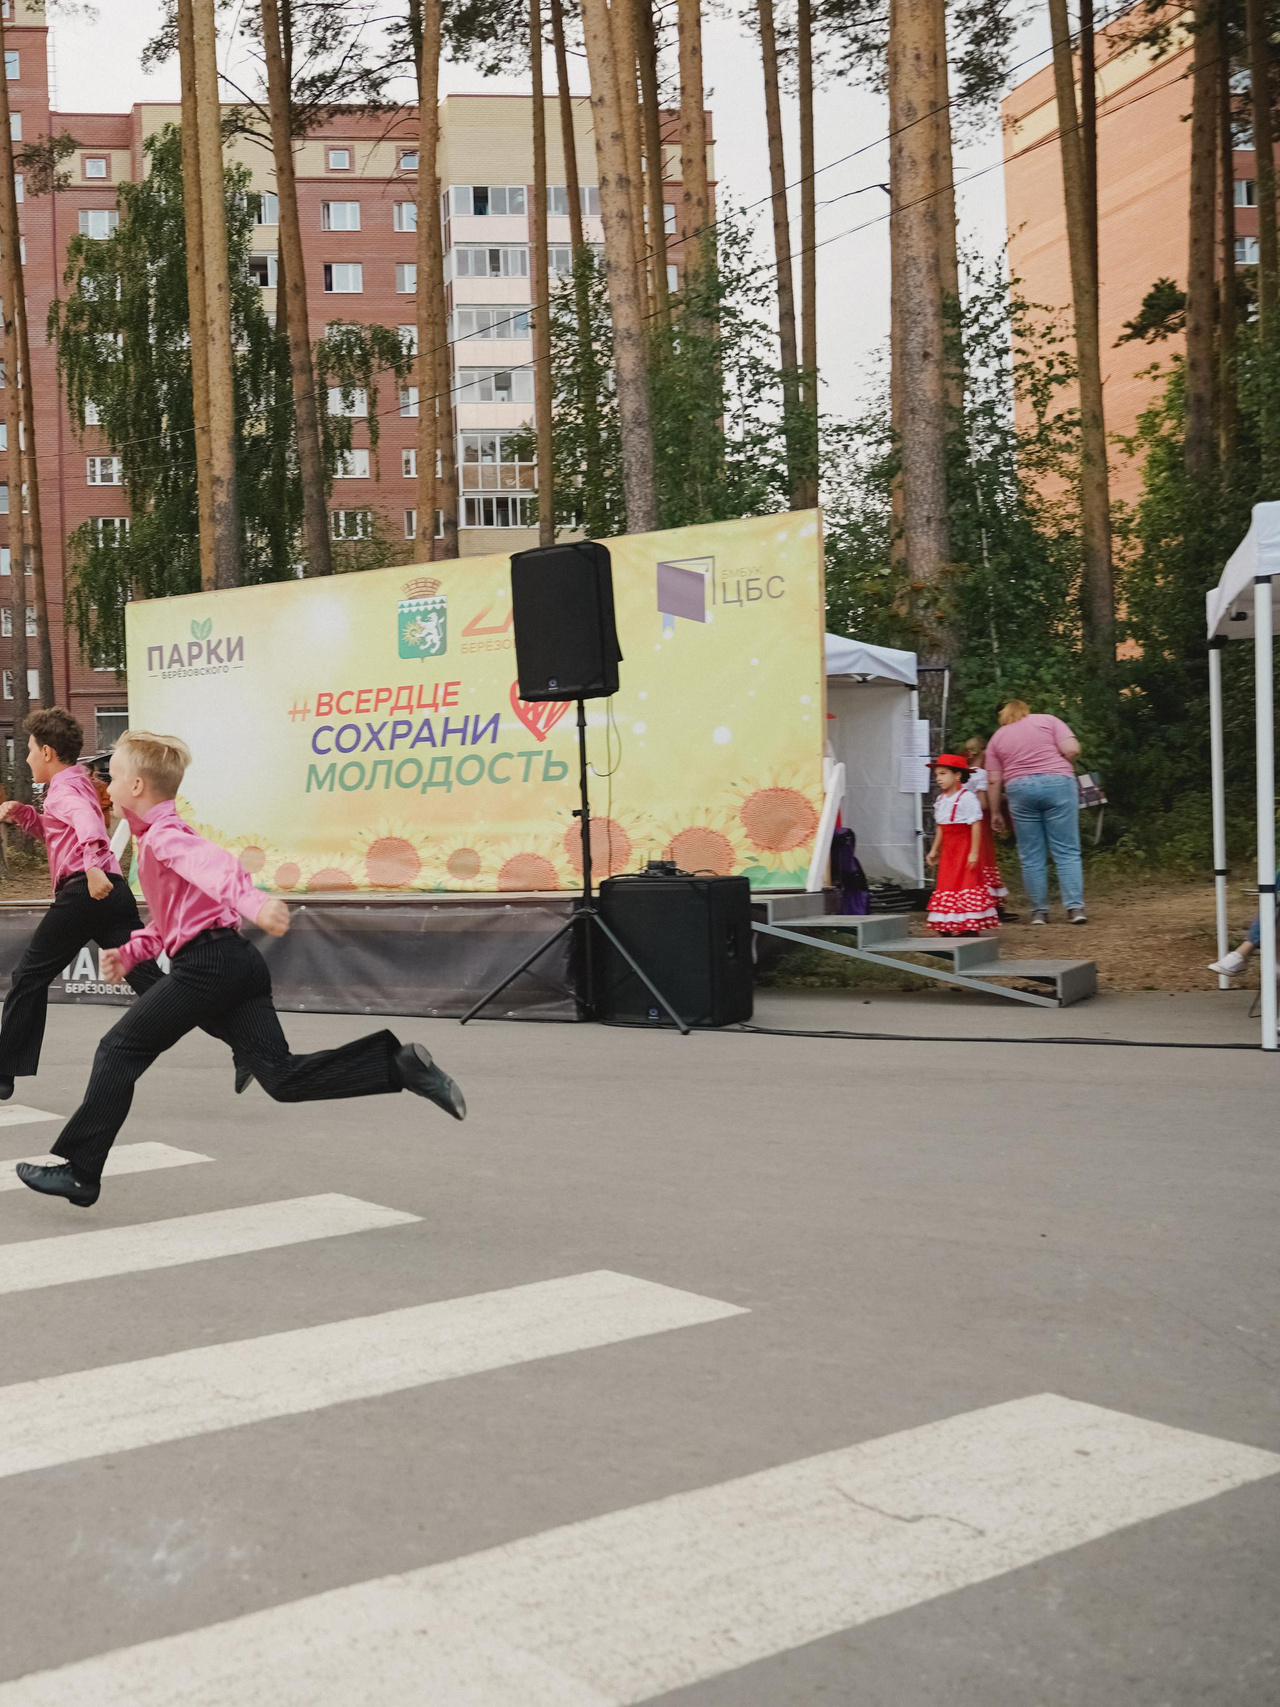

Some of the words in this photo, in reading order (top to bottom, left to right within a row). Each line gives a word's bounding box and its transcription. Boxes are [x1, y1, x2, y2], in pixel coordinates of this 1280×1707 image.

[722, 575, 785, 607] ЦБС
[147, 636, 244, 671] ПАРКИ
[461, 638, 517, 653] БЕРЁЗО
[161, 665, 229, 679] БЕРЁЗОВСКОГО
[288, 681, 461, 722] #ВСЕРДЦЕ
[311, 713, 501, 755] СОХРАНИ
[305, 750, 569, 794] МОЛОДОСТЬ
[65, 981, 136, 995] БЕРЁЗОВСКО
